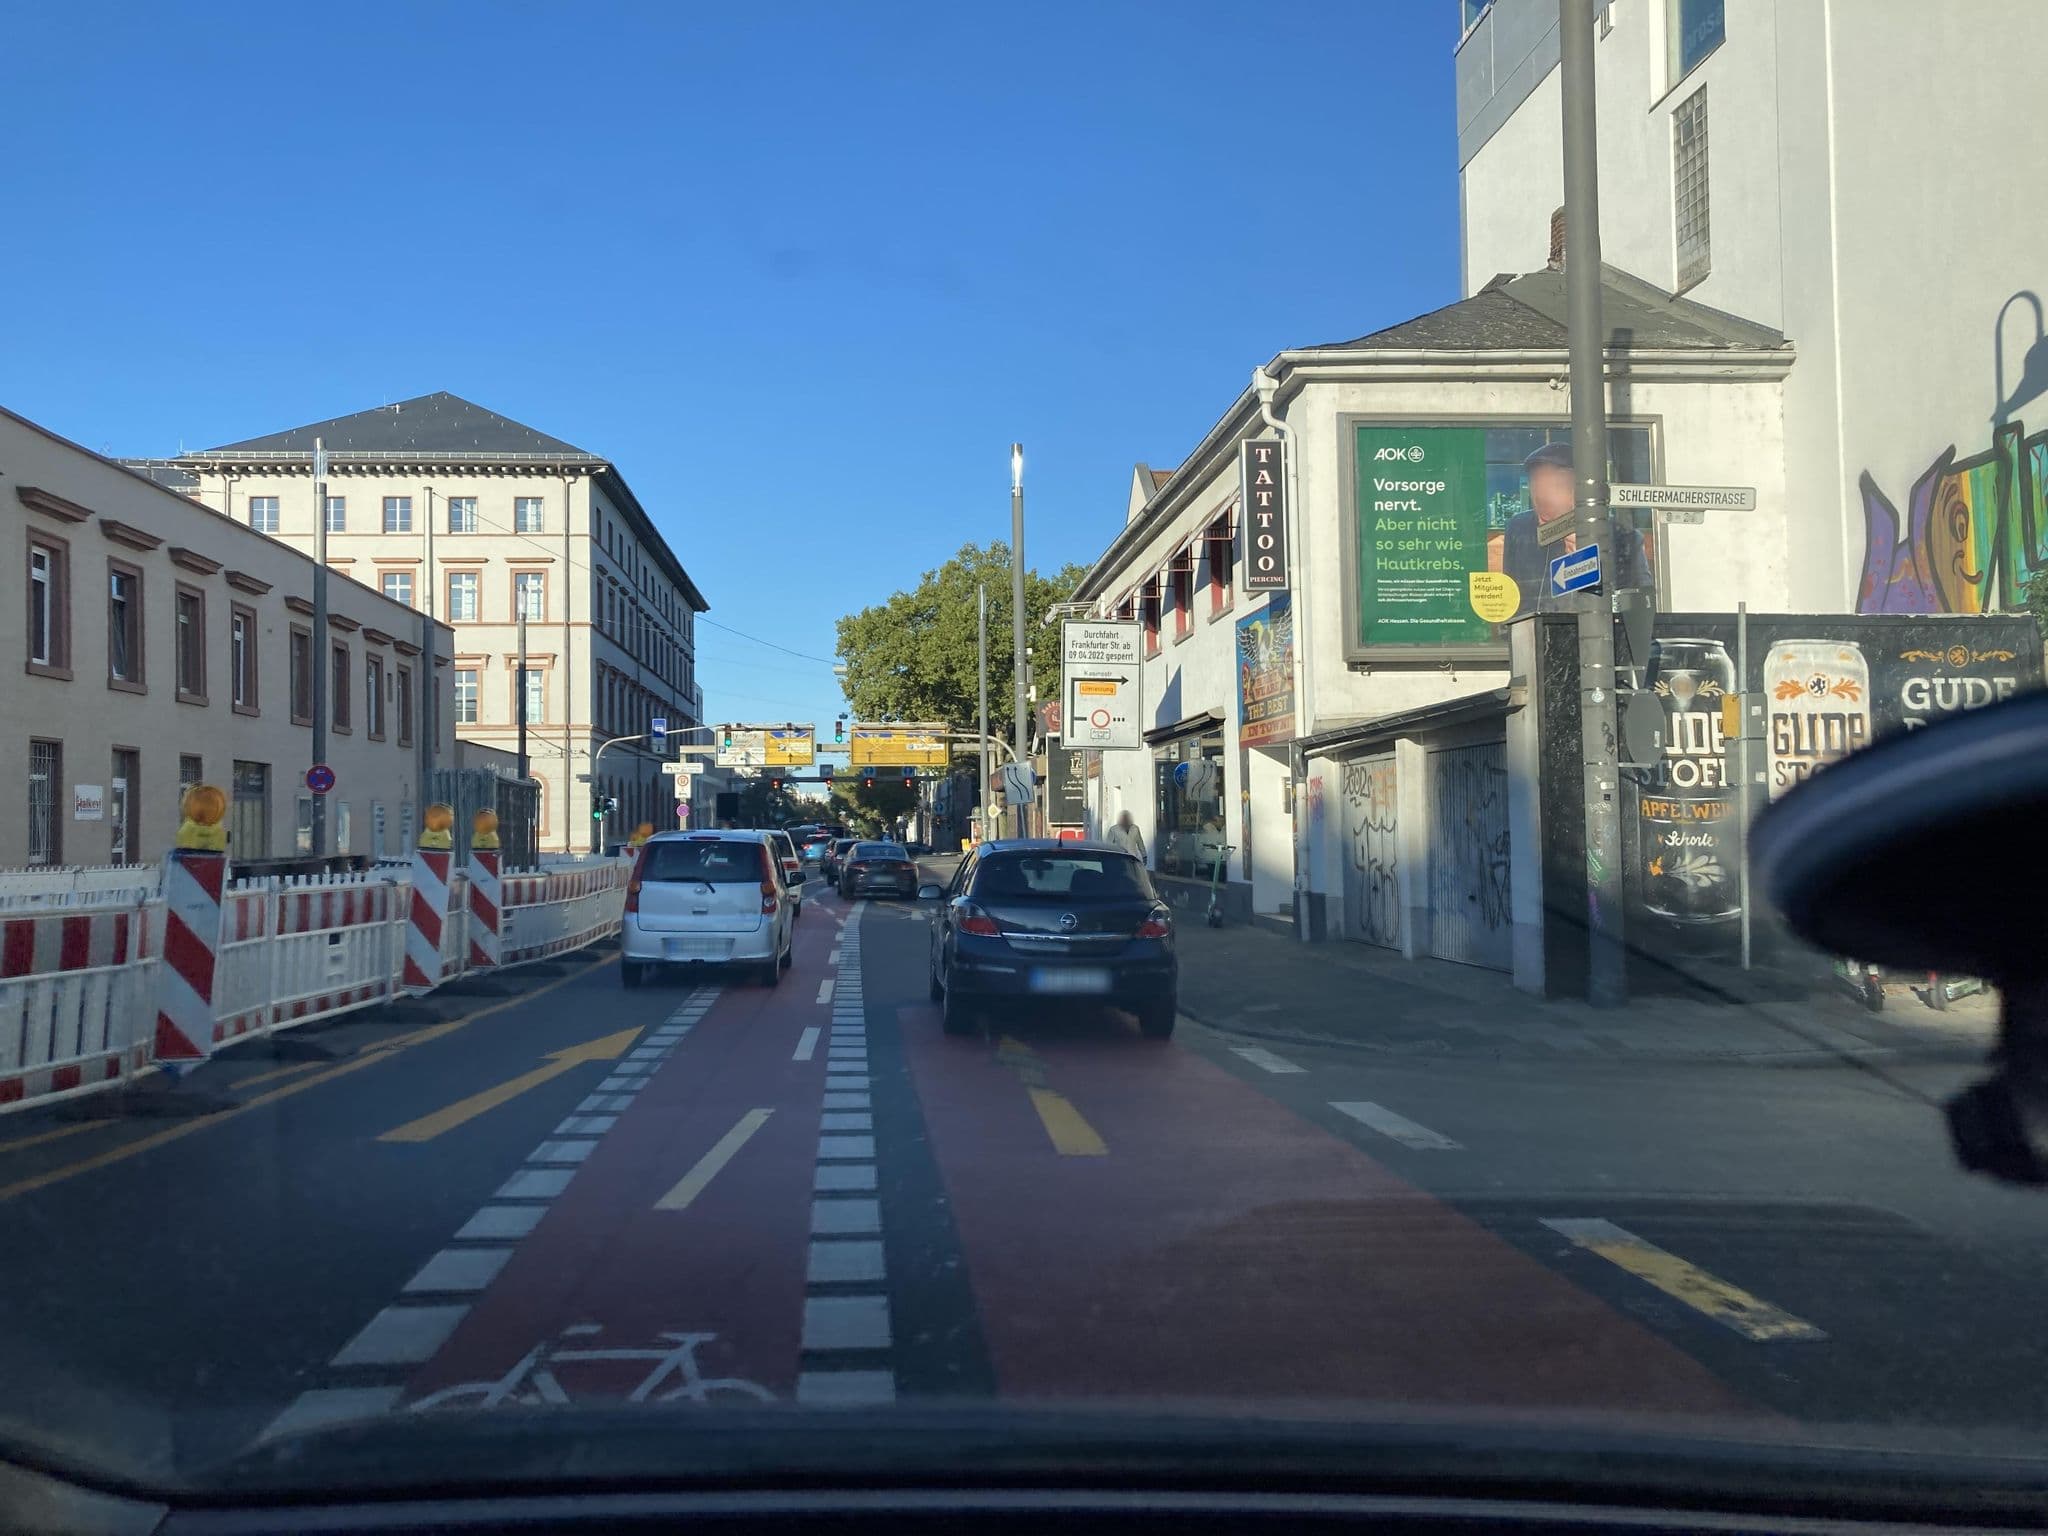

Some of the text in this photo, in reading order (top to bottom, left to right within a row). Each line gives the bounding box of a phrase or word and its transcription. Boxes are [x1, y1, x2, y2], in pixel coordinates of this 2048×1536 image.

[1374, 448, 1407, 461] AOK
[1373, 478, 1446, 495] Vorsorge
[1619, 488, 1747, 505] SCHLEIERMACHERSTRASSE
[1255, 448, 1275, 571] TATTOO
[1374, 499, 1422, 511] nervt.
[1375, 517, 1457, 531] Aber nicht
[1376, 537, 1463, 551] so sehr wie
[1376, 556, 1465, 571] Hautkrebs.
[1249, 575, 1284, 583] PIERCING
[1474, 592, 1503, 600] werden!
[1084, 629, 1119, 640] Durchfahrt
[1071, 640, 1131, 651] Frankfurter Str. ab
[1105, 653, 1134, 661] gesperrt
[1248, 694, 1289, 720] THE BEST
[1665, 711, 1725, 755] UDE
[1665, 830, 1715, 847] Schorle
